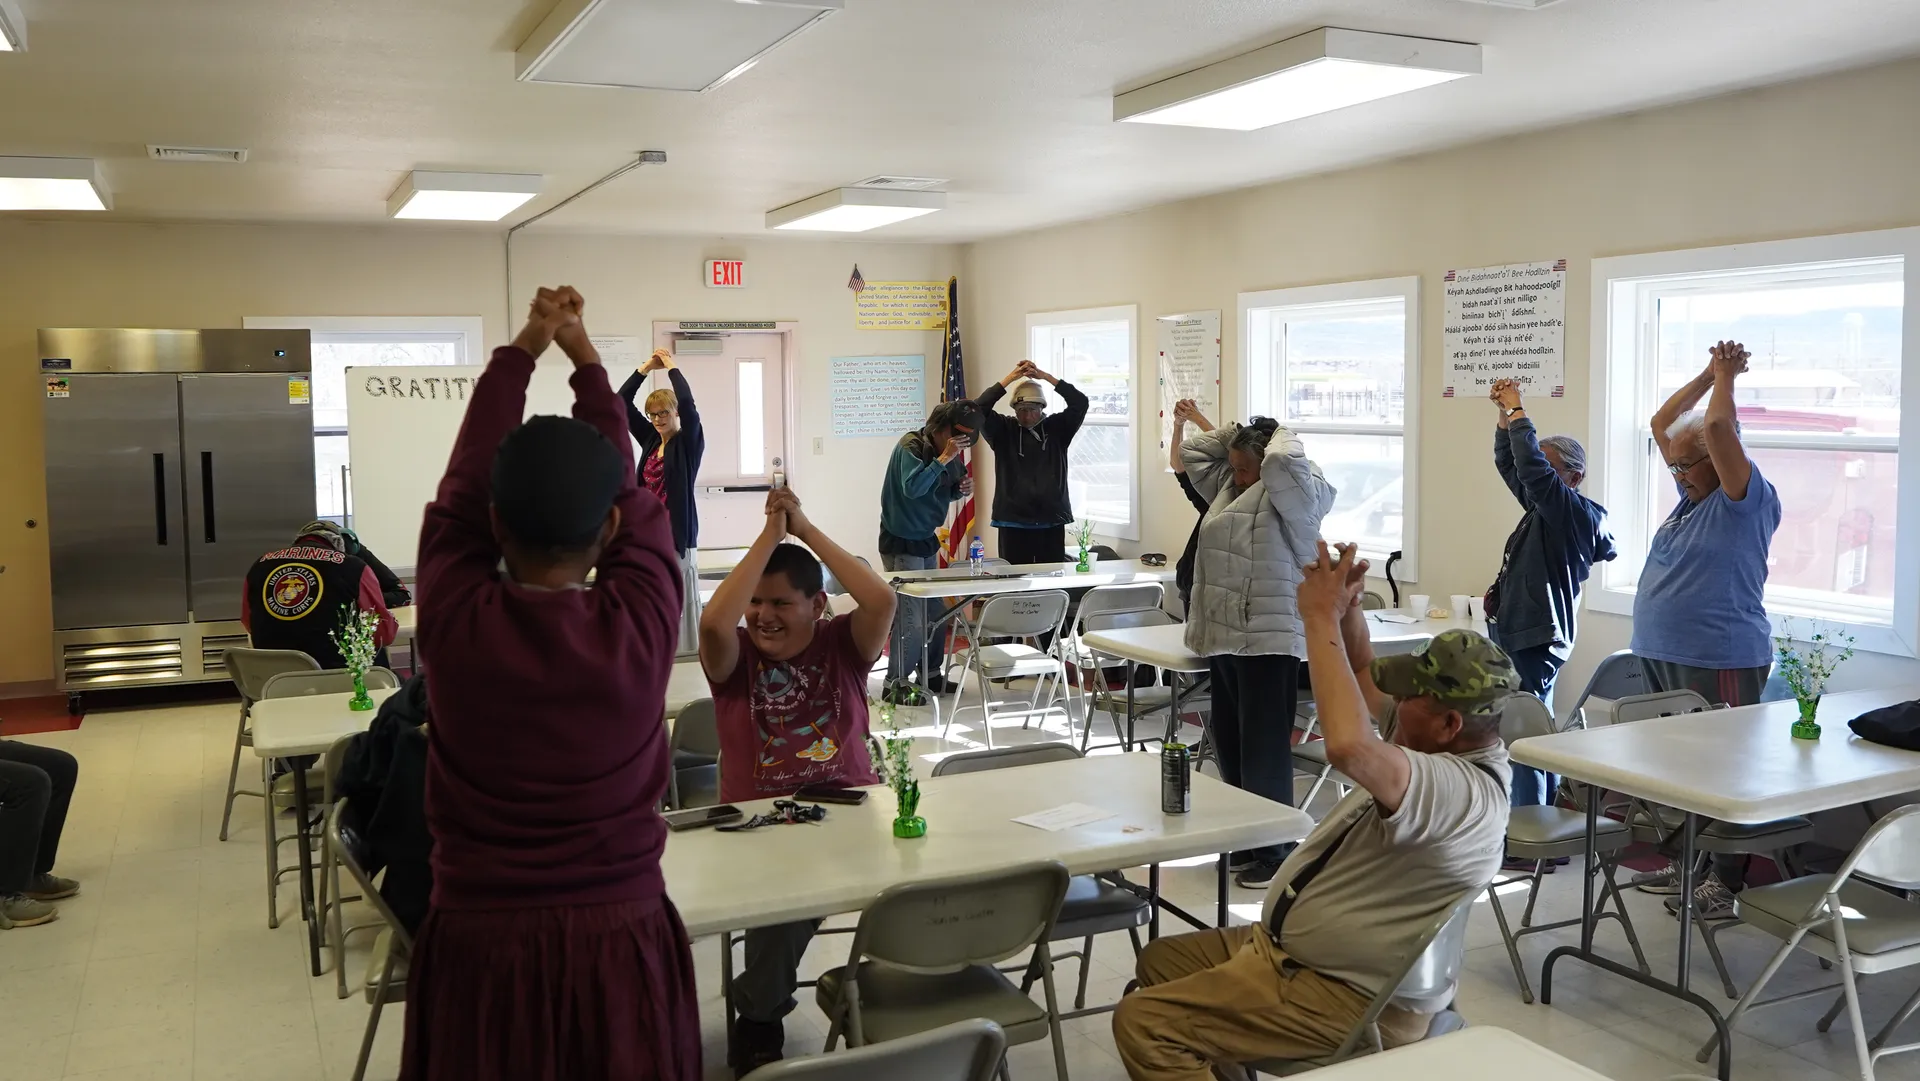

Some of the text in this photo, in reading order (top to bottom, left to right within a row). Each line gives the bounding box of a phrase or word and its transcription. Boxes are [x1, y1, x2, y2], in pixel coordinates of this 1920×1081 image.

[714, 261, 742, 285] EXIT
[260, 547, 345, 564] MARINES
[269, 568, 316, 586] UNITED STATES
[267, 596, 314, 615] MARINE CORPS
